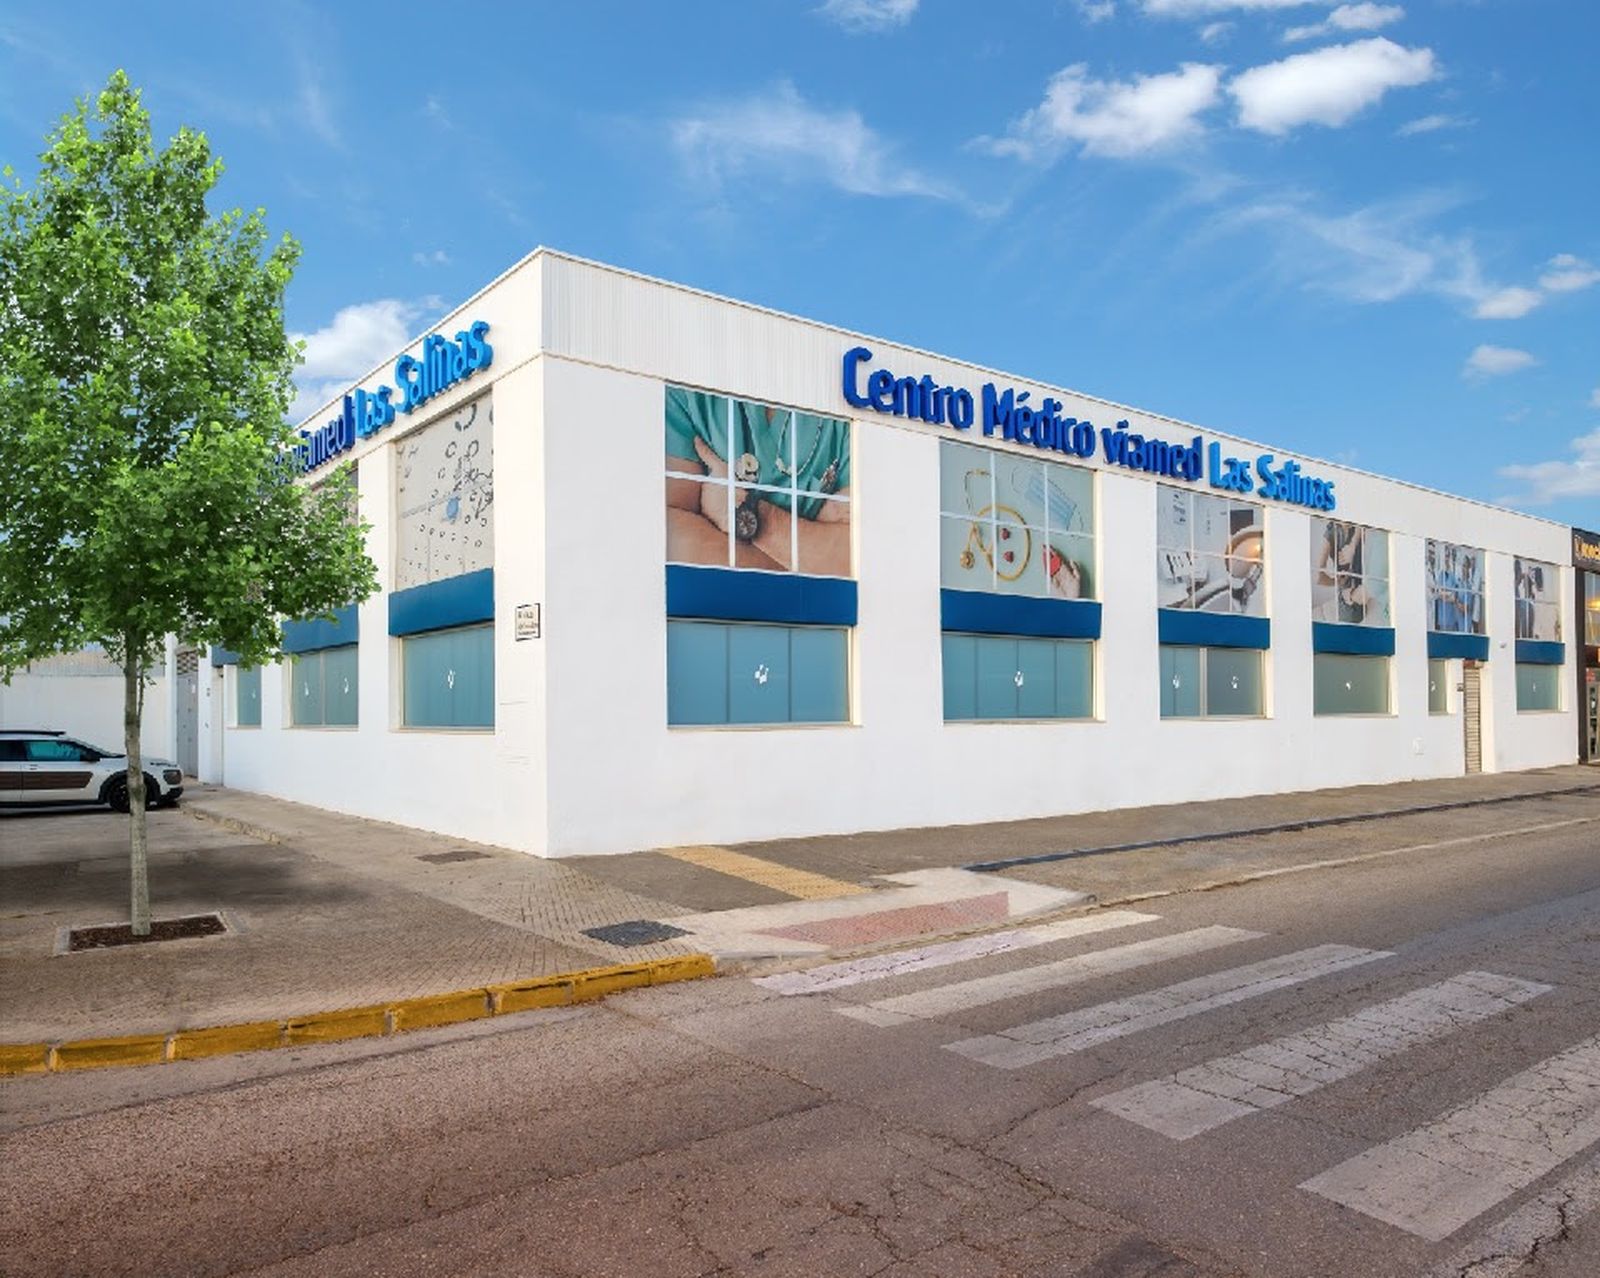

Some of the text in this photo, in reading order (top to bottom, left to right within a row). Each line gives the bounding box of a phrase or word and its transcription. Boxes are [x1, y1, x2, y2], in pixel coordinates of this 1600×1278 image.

[354, 385, 395, 439] Las
[394, 320, 494, 414] Salinas
[843, 346, 974, 430] Centro
[982, 382, 1096, 458] Médico
[1208, 441, 1254, 494] Las
[1256, 454, 1336, 512] Salinas
